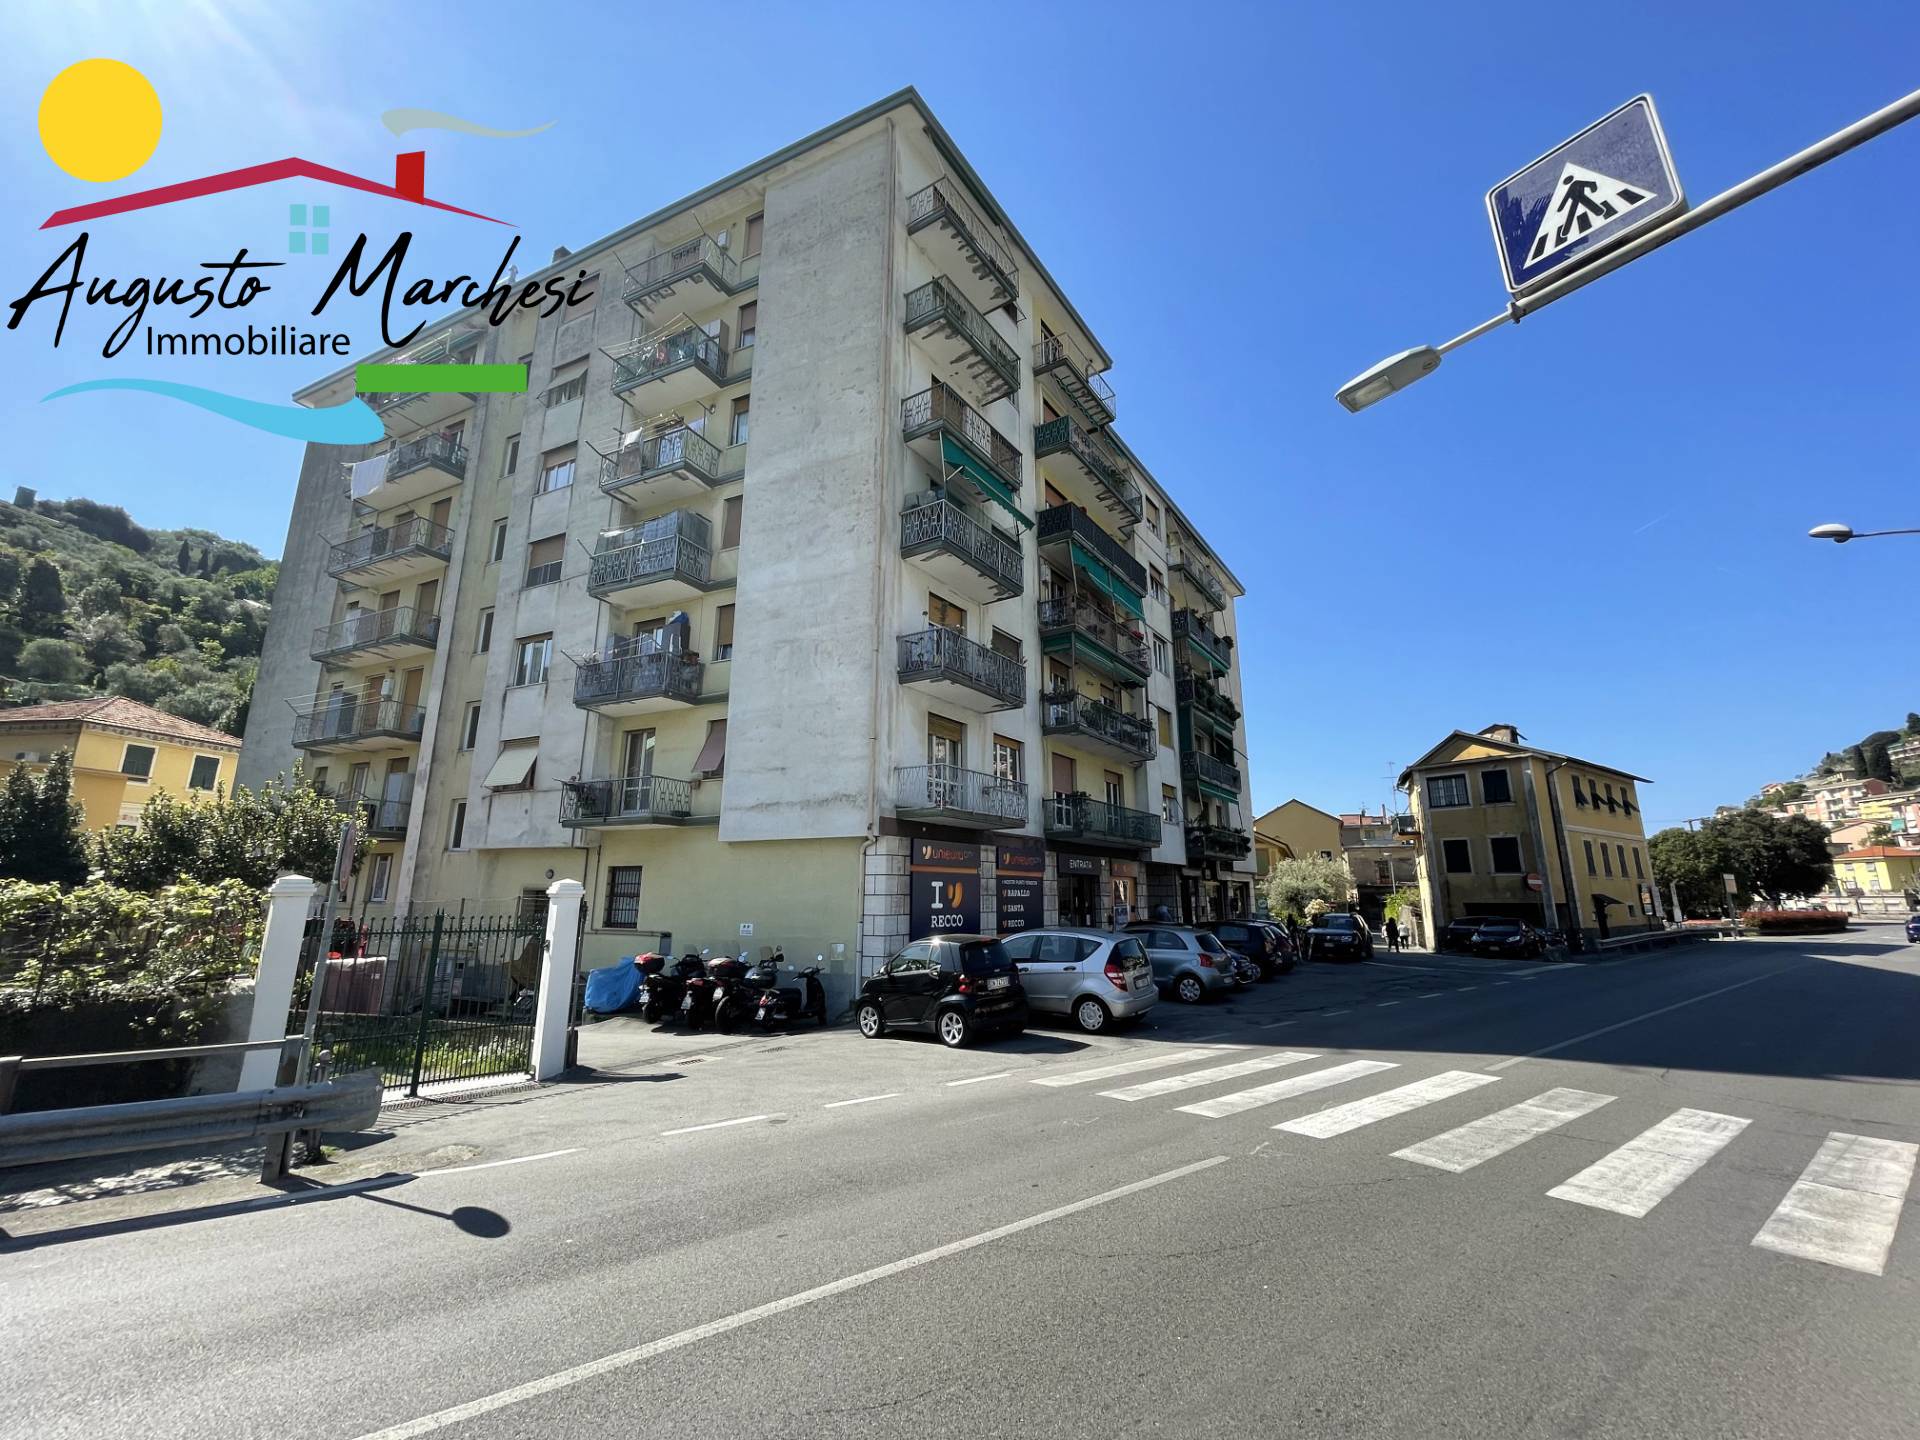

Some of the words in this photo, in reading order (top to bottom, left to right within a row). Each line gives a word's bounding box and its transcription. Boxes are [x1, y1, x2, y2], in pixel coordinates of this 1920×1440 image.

[931, 881, 943, 909] I
[930, 914, 964, 929] RECCO
[1007, 919, 1025, 928] RECCO
